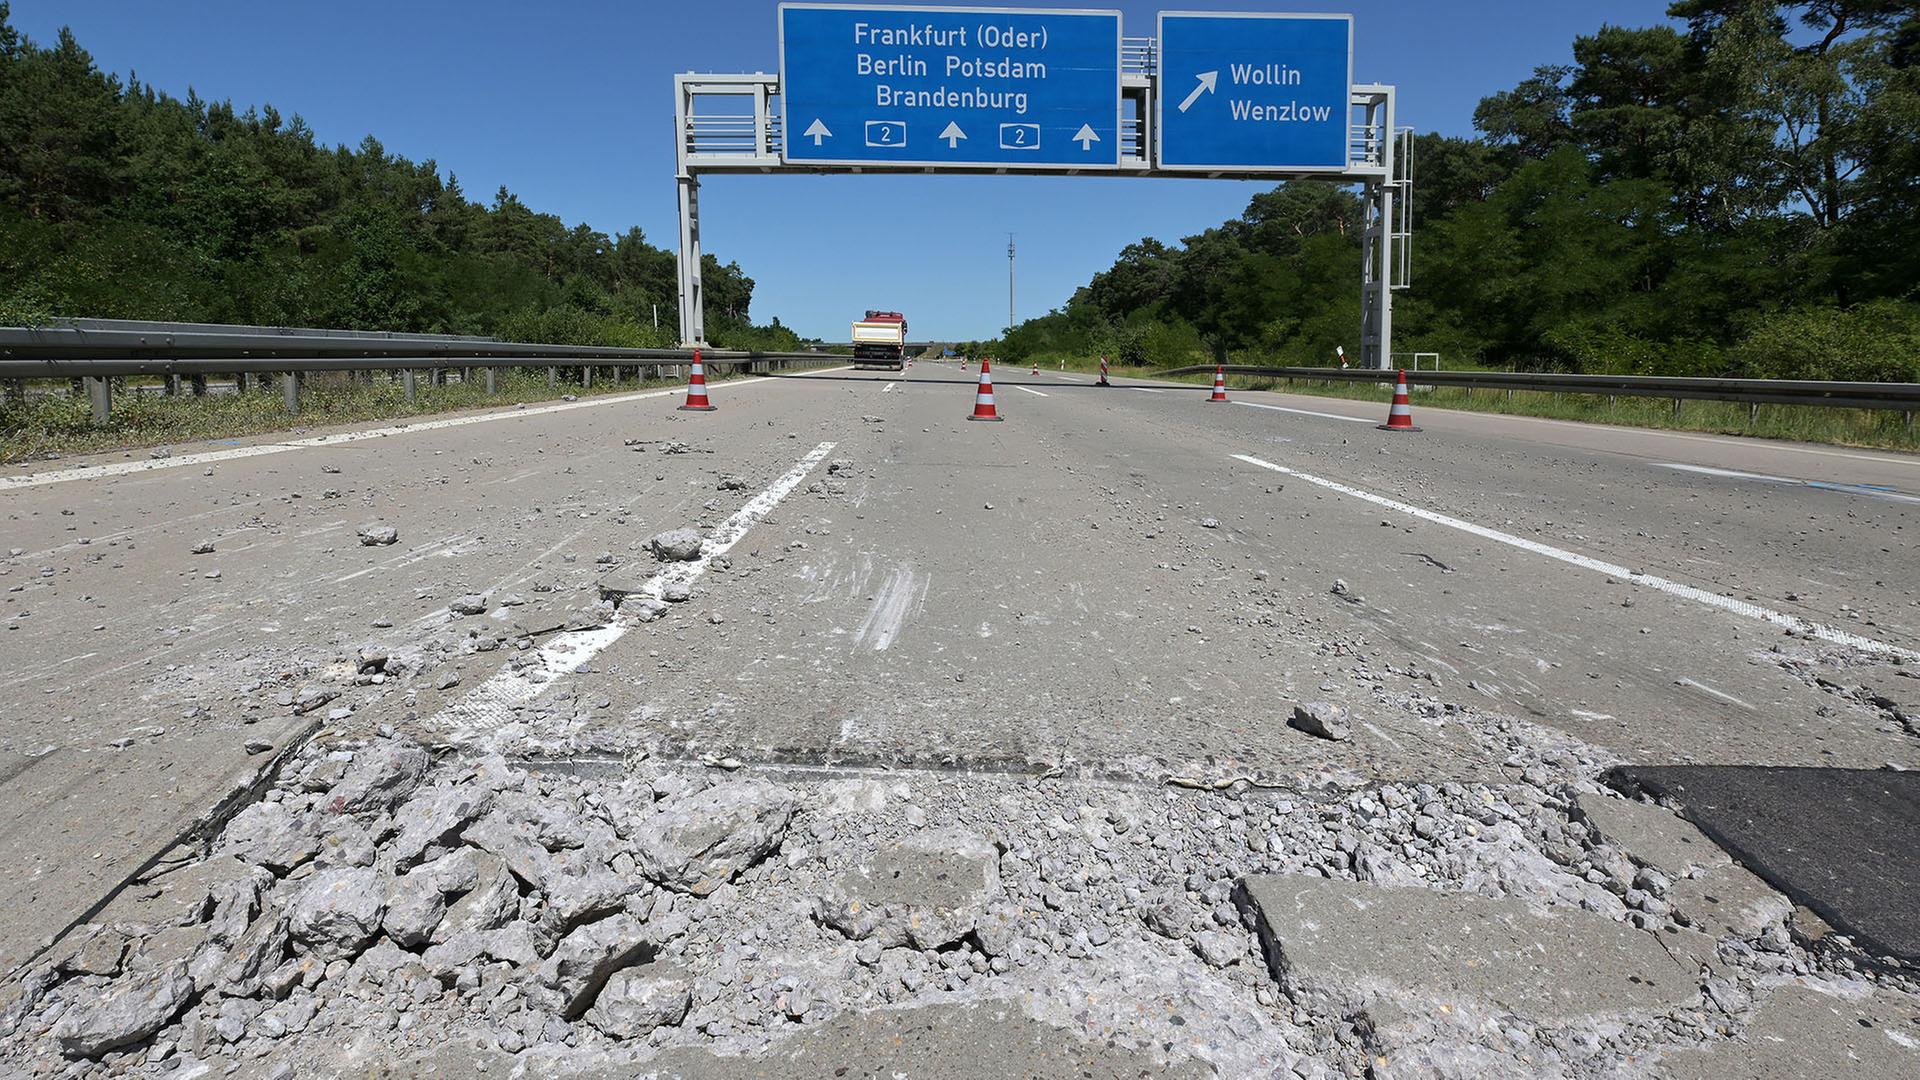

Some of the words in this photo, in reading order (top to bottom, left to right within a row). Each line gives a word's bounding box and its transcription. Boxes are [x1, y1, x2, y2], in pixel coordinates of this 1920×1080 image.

[854, 22, 968, 47] Frankfurt
[976, 24, 1048, 50] (Oder)
[857, 53, 927, 77] Berlin
[945, 55, 1047, 79] Potsdam
[1230, 63, 1301, 85] Wollin
[876, 84, 1028, 114] Brandenburg
[1230, 99, 1331, 122] Wenzlow
[881, 126, 890, 142] 2
[1015, 128, 1025, 144] 2
